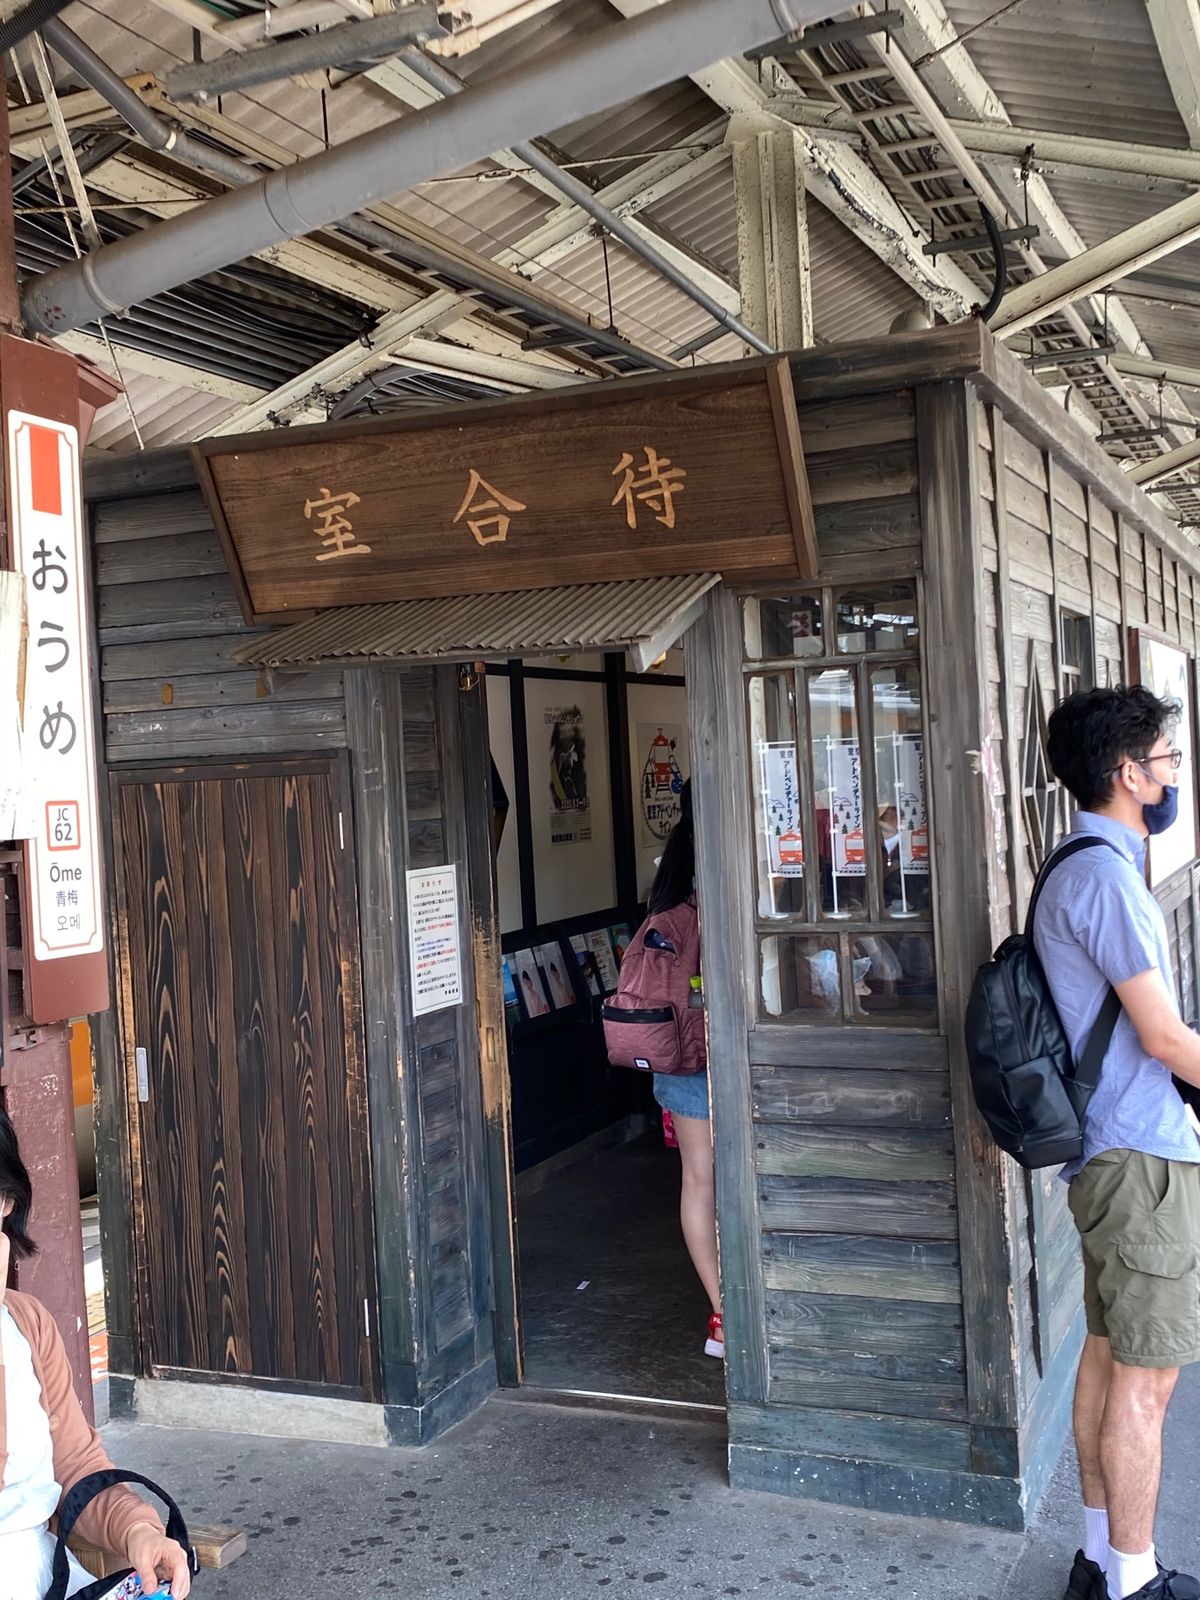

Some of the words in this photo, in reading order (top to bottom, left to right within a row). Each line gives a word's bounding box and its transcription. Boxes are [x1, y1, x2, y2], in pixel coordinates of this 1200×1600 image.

[303, 446, 688, 562] 待合室
[31, 537, 77, 756] おうめ
[57, 808, 69, 821] JC
[647, 803, 682, 820] 東京アドベンチャ
[55, 823, 73, 842] 62
[49, 862, 82, 882] Ōme
[56, 889, 78, 907] 青梅
[57, 913, 81, 931] 오메
